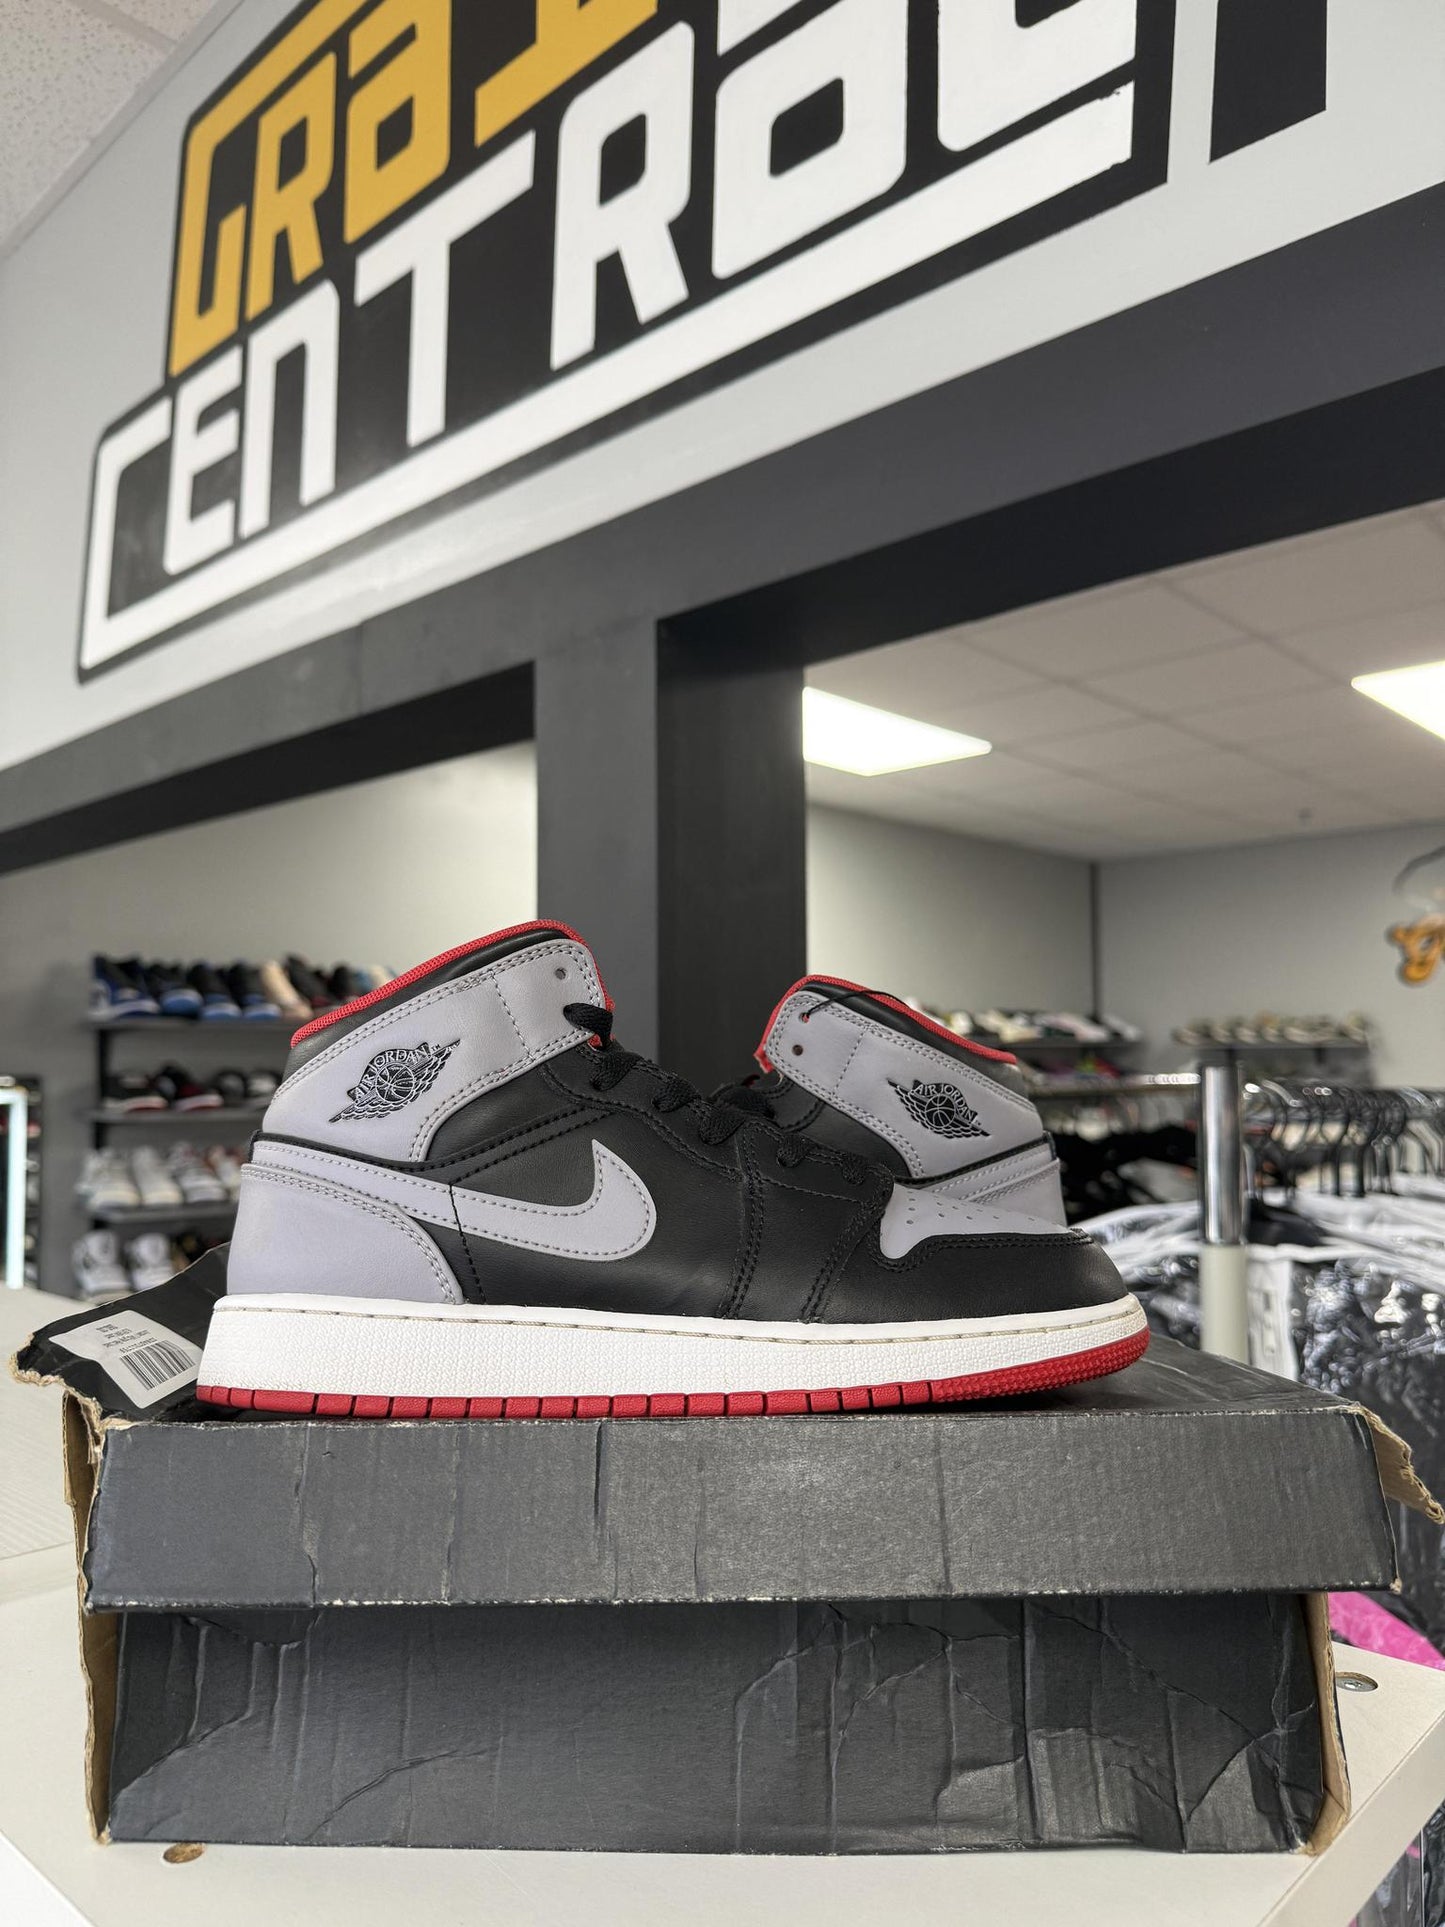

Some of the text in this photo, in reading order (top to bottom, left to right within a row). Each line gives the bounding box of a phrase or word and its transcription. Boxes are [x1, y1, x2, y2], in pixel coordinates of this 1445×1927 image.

[354, 1073, 375, 1102] AIR
[368, 1043, 433, 1074] JORDAN
[911, 1083, 978, 1124] AIR JORDAN
